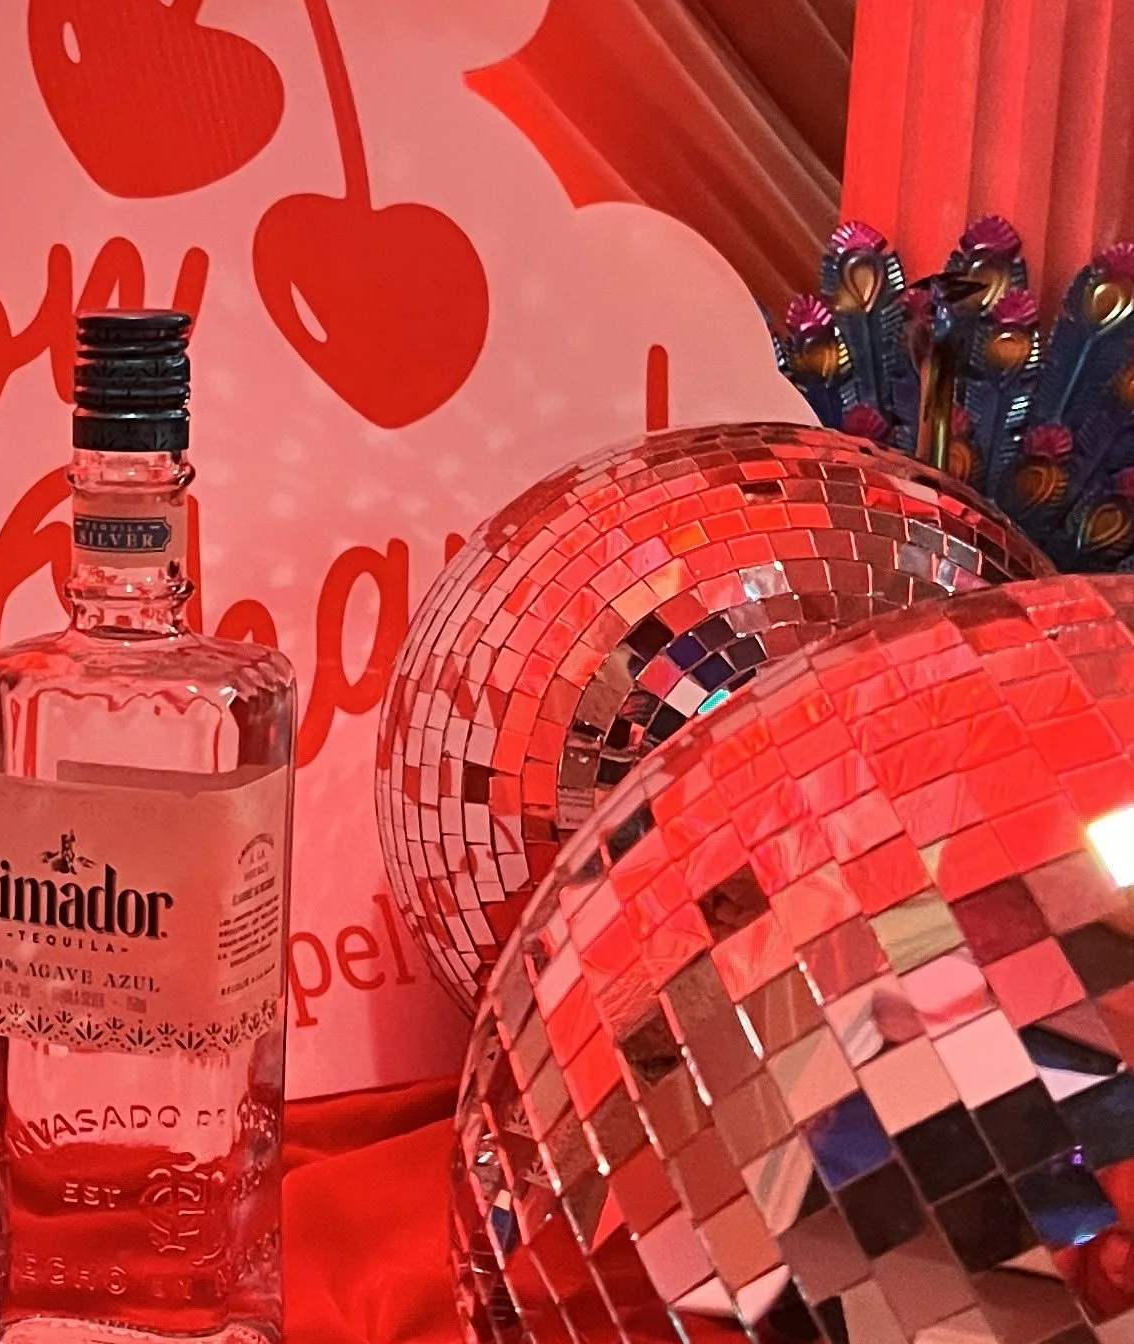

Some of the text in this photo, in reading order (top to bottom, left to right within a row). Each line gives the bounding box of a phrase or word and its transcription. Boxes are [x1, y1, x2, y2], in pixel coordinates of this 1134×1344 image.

[78, 529, 154, 548] SILVER
[24, 960, 93, 986] AGAVE
[102, 972, 161, 994] AZUL
[6, 1103, 182, 1159] NVASADO
[62, 1181, 122, 1208] EST
